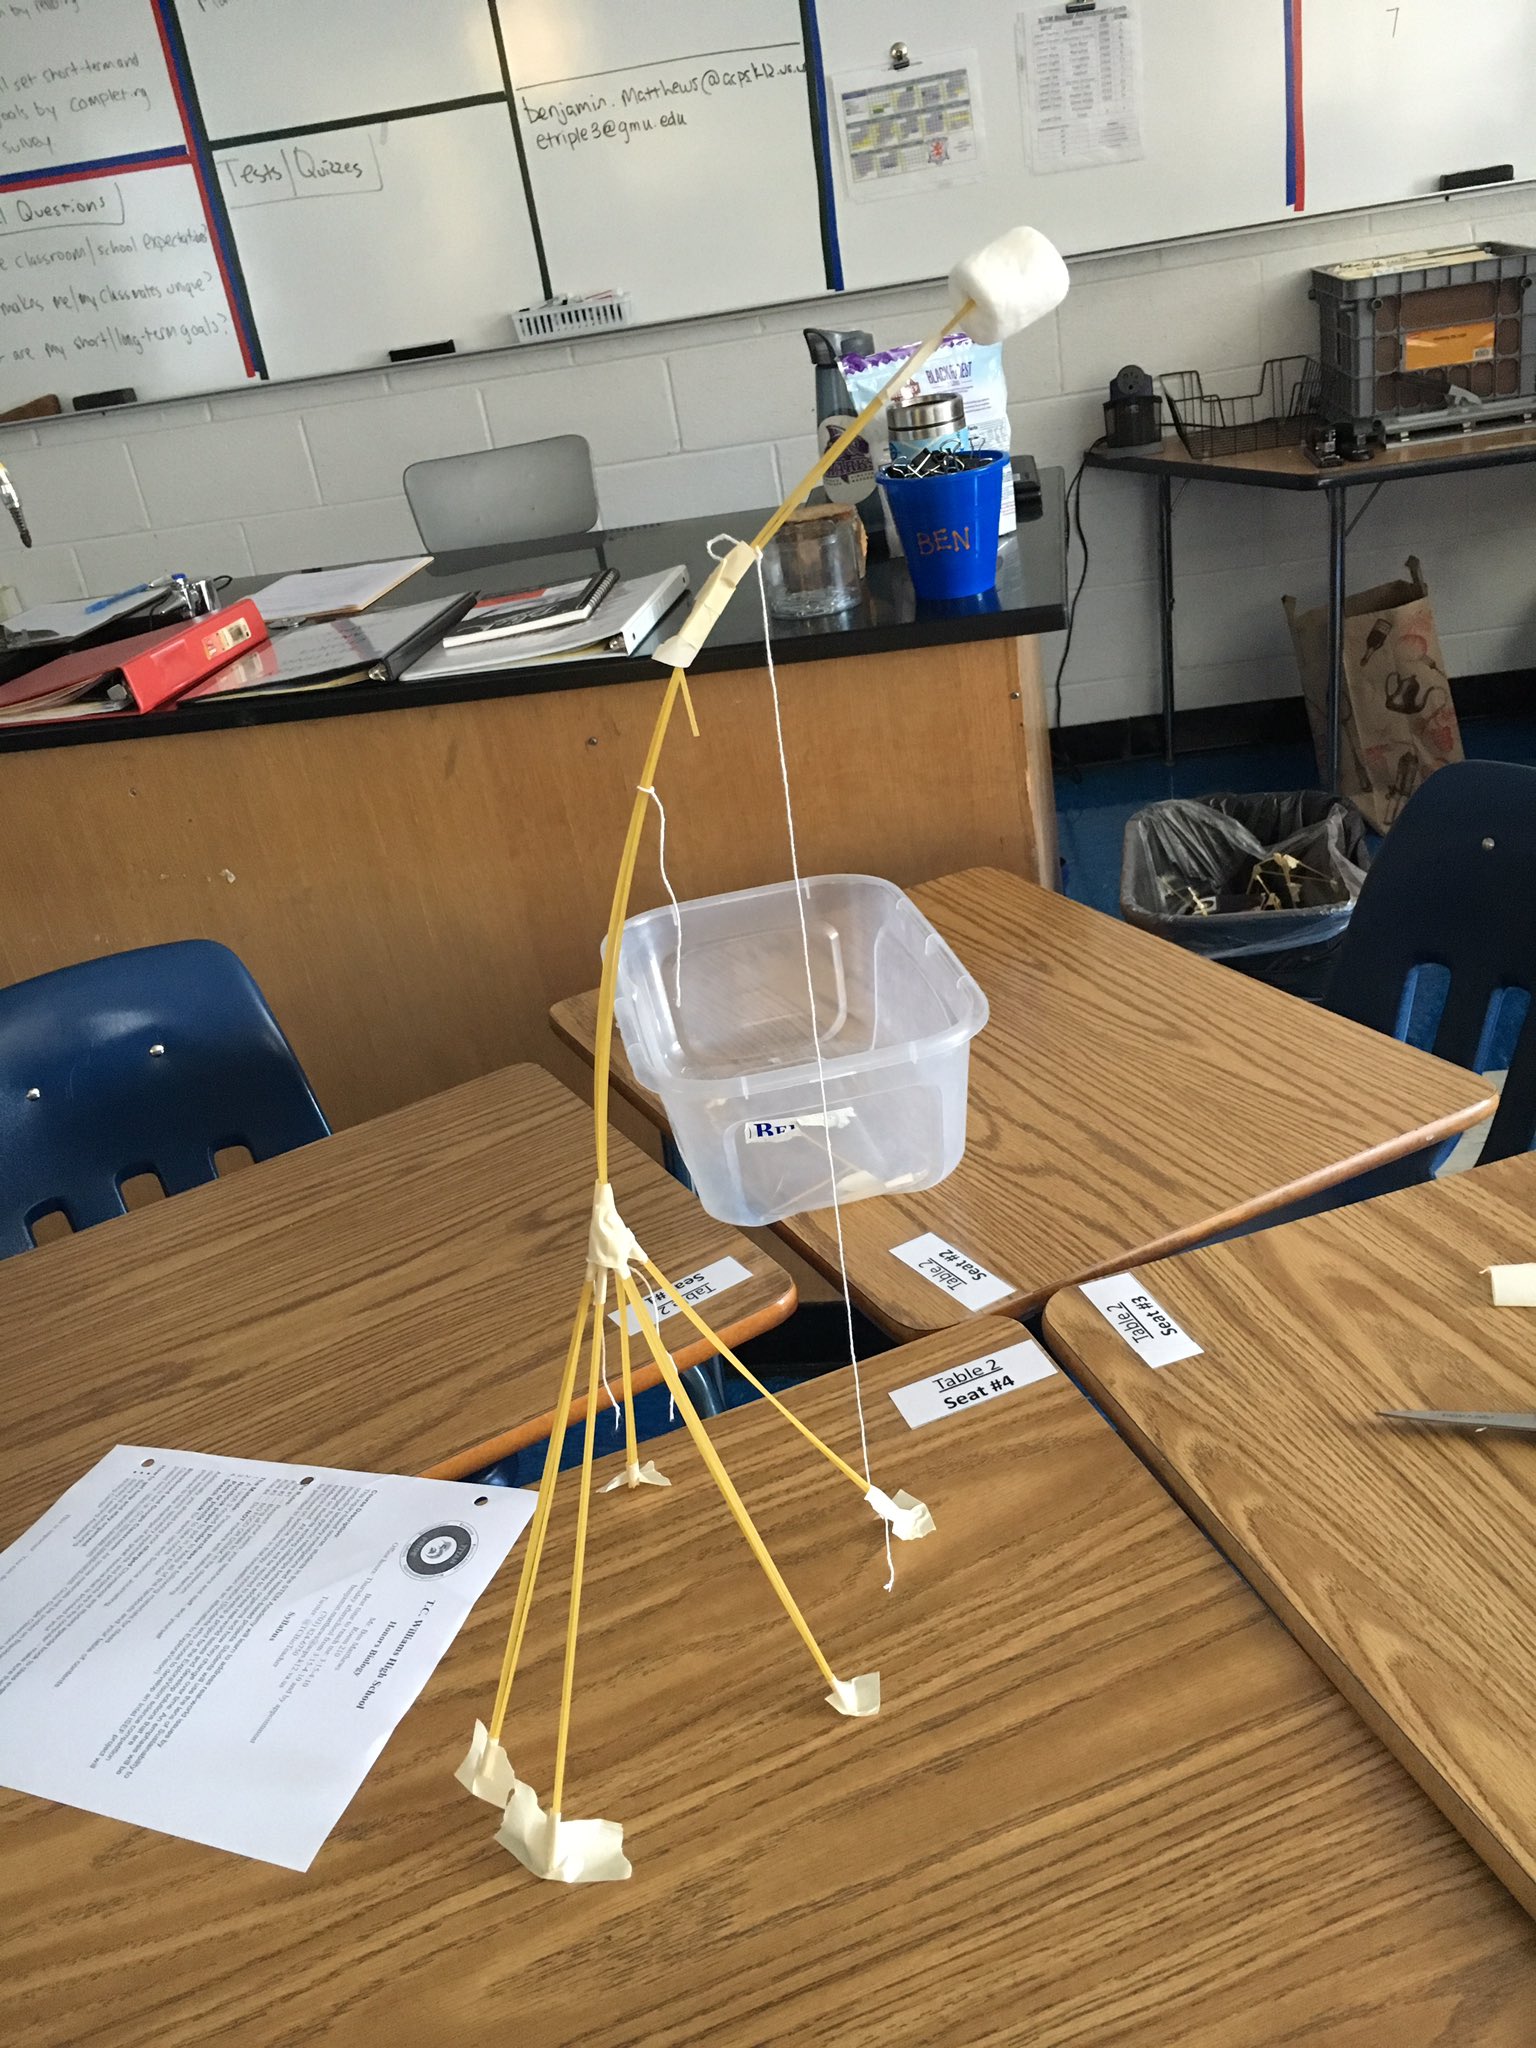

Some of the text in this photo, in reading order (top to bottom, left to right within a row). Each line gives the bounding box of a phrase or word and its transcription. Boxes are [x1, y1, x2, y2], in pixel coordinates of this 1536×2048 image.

[33, 101, 58, 121] by
[16, 195, 106, 223] Questions
[916, 527, 971, 556] BEN
[918, 1258, 964, 1292] Table 2
[938, 1248, 988, 1282] Seat #2
[674, 1273, 705, 1290] Sea
[1106, 1301, 1150, 1345] Table 2
[1130, 1295, 1179, 1337] Seat #3
[931, 1358, 1002, 1391] Table 2
[943, 1374, 1016, 1410] Seat #4
[350, 1576, 373, 1602] Thursday
[268, 1610, 296, 1641] Syllabus
[315, 1636, 330, 1651] from
[333, 1644, 345, 1657] 210
[334, 1642, 359, 1670] Matthews
[352, 1620, 397, 1677] Honors Biology
[355, 1599, 436, 1710] T.C. Williams High School
[277, 1694, 289, 1703] by
[285, 1681, 296, 1694] and
[249, 1703, 280, 1744] appointment
